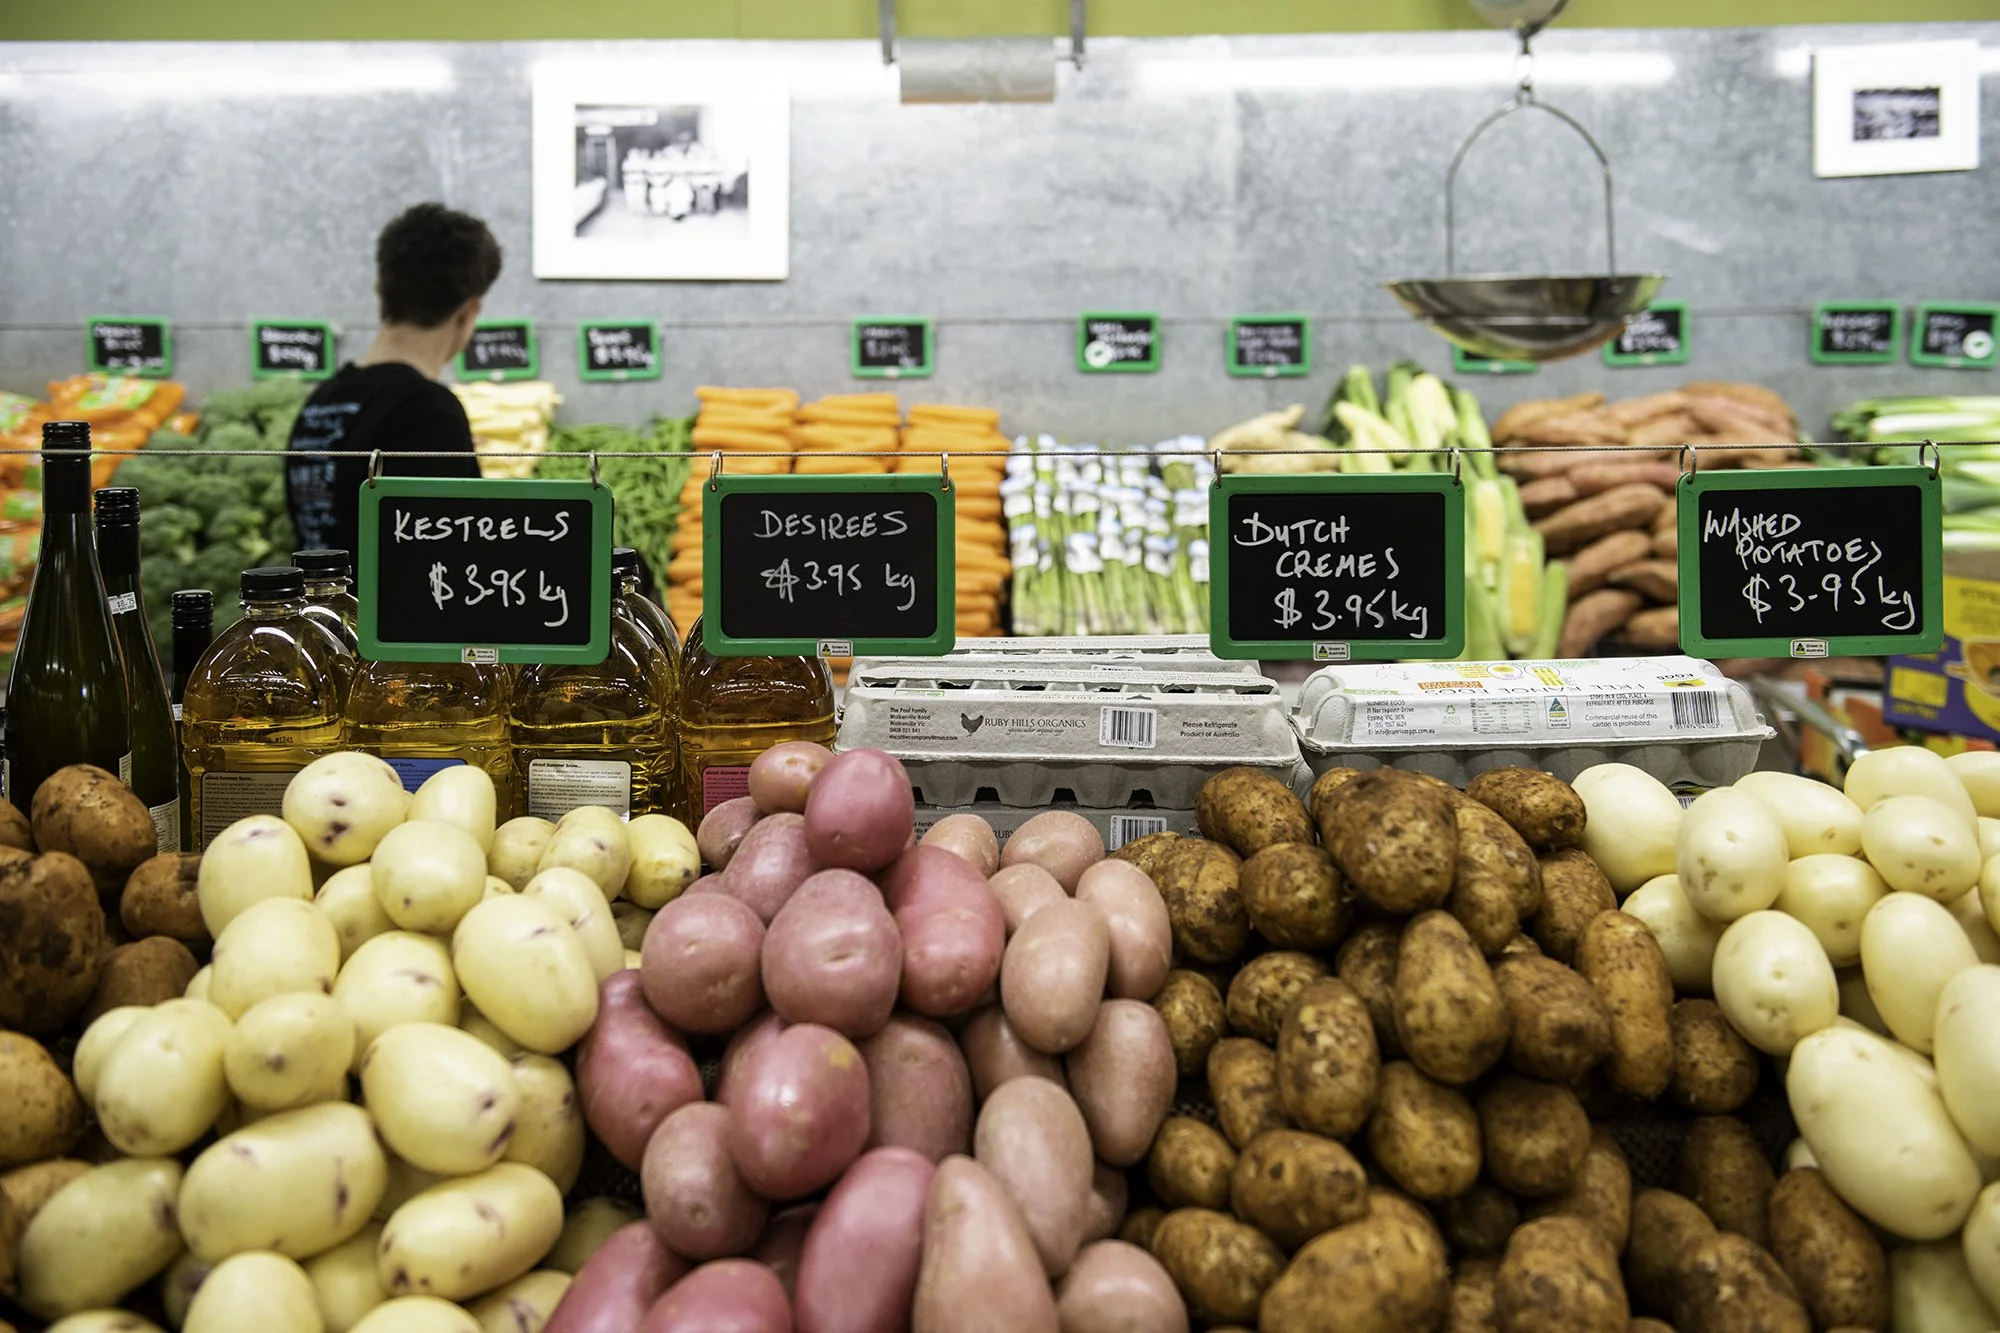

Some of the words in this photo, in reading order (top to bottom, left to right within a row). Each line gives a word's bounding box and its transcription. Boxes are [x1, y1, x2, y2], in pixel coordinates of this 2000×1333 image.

[394, 509, 570, 543] KESTRELS
[753, 510, 908, 541] DESIREES
[1233, 512, 1350, 547] DUTCH
[1275, 547, 1400, 580] CREMES
[1736, 537, 1882, 571] POTATOES
[885, 563, 917, 612] kg
[984, 718, 1009, 727] RUBY
[1011, 718, 1035, 727] HILLS
[1037, 719, 1086, 728] ORGANICS
[1619, 720, 1651, 728] prohibited.
